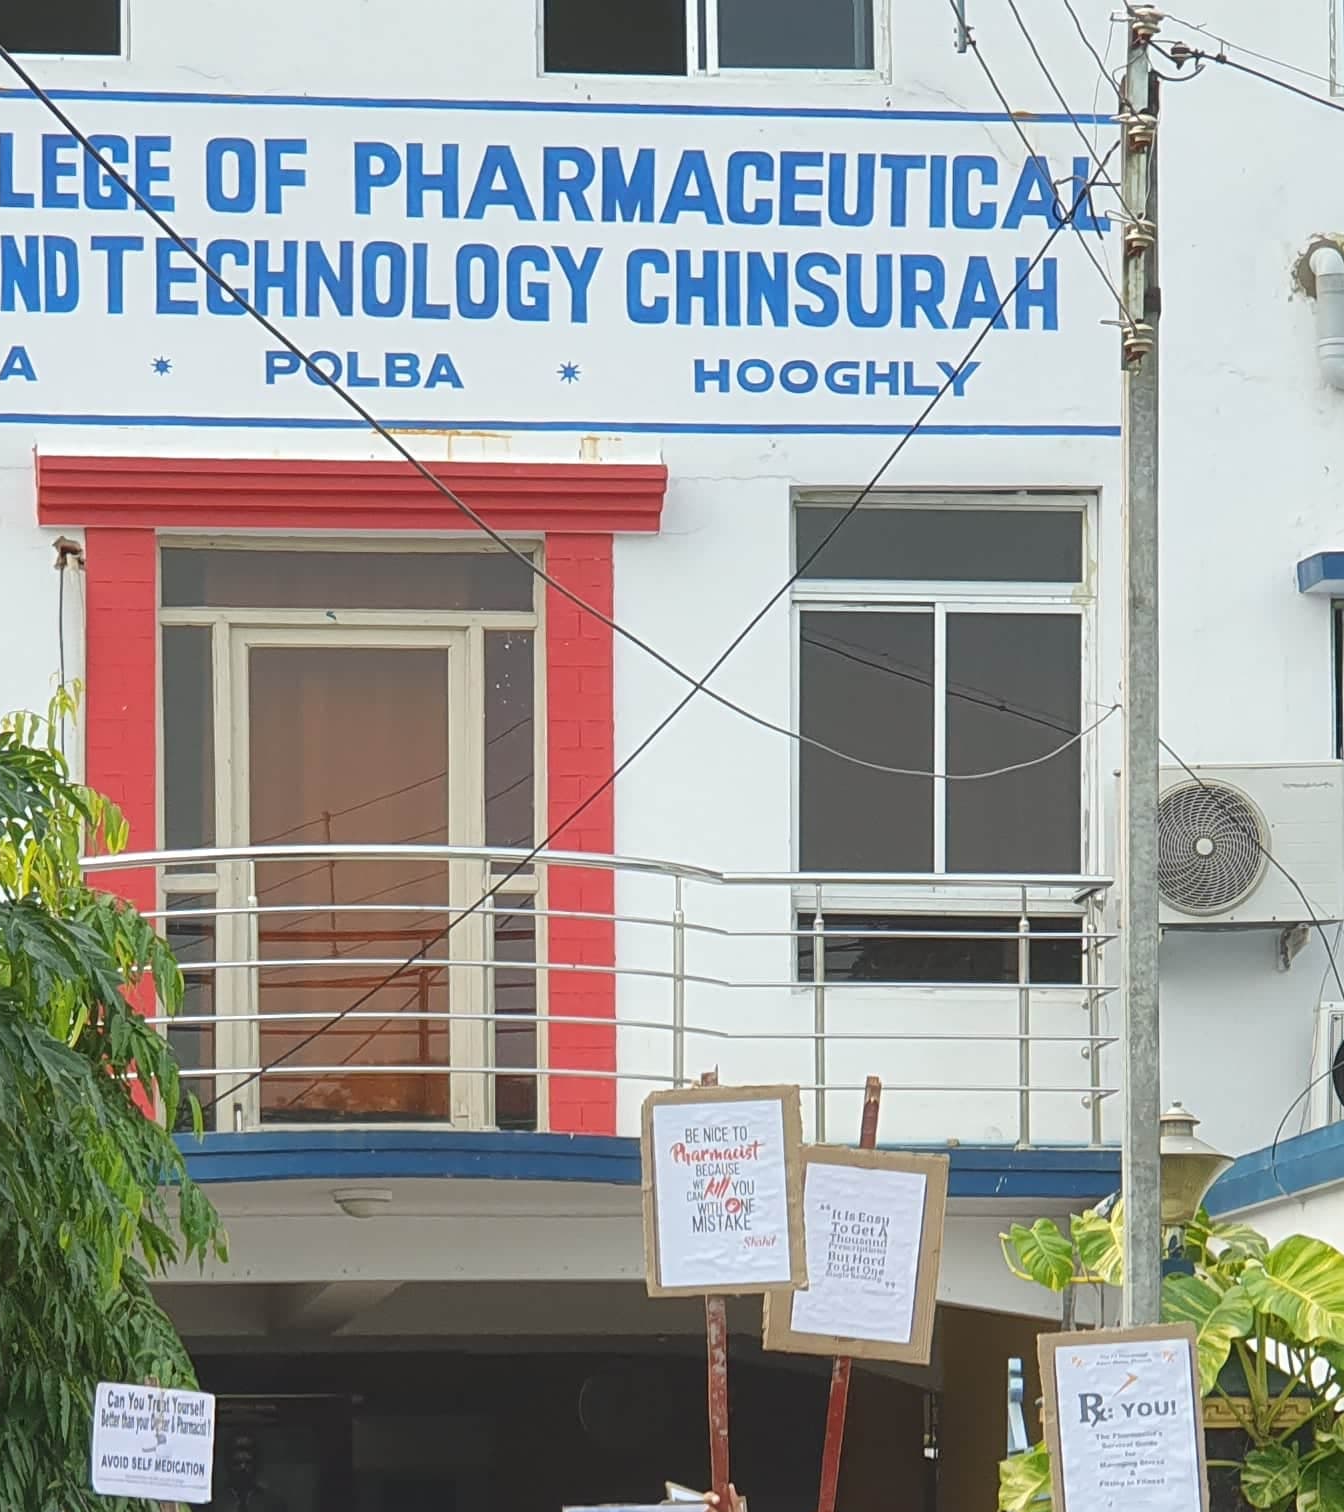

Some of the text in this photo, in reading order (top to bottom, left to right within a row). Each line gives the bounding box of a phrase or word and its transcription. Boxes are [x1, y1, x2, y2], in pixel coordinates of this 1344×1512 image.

[206, 136, 306, 214] OF
[355, 141, 1111, 232] PHARMACEUTICAL
[626, 248, 1058, 331] CHINSURAH
[265, 350, 464, 389] POLBA
[694, 359, 981, 398] HOOGHLY
[685, 1126, 747, 1143] BE NICE TO
[670, 1139, 765, 1165] Pharmacist
[696, 1163, 740, 1176] BECAUSE
[693, 1179, 704, 1190] WE
[732, 1180, 755, 1195] YOU
[687, 1192, 704, 1201] CAN
[698, 1201, 724, 1216] WITH
[693, 1214, 752, 1233] MISTAKE
[858, 1212, 890, 1228] Easy
[831, 1222, 848, 1233] To
[851, 1223, 874, 1237] Get
[107, 1390, 125, 1409] Can
[128, 1391, 145, 1411] You
[171, 1396, 205, 1417] Yourself
[1121, 1400, 1176, 1418] YOU!
[101, 1408, 121, 1428] Better
[101, 1454, 205, 1477] AVOID SELF MEDICATION
